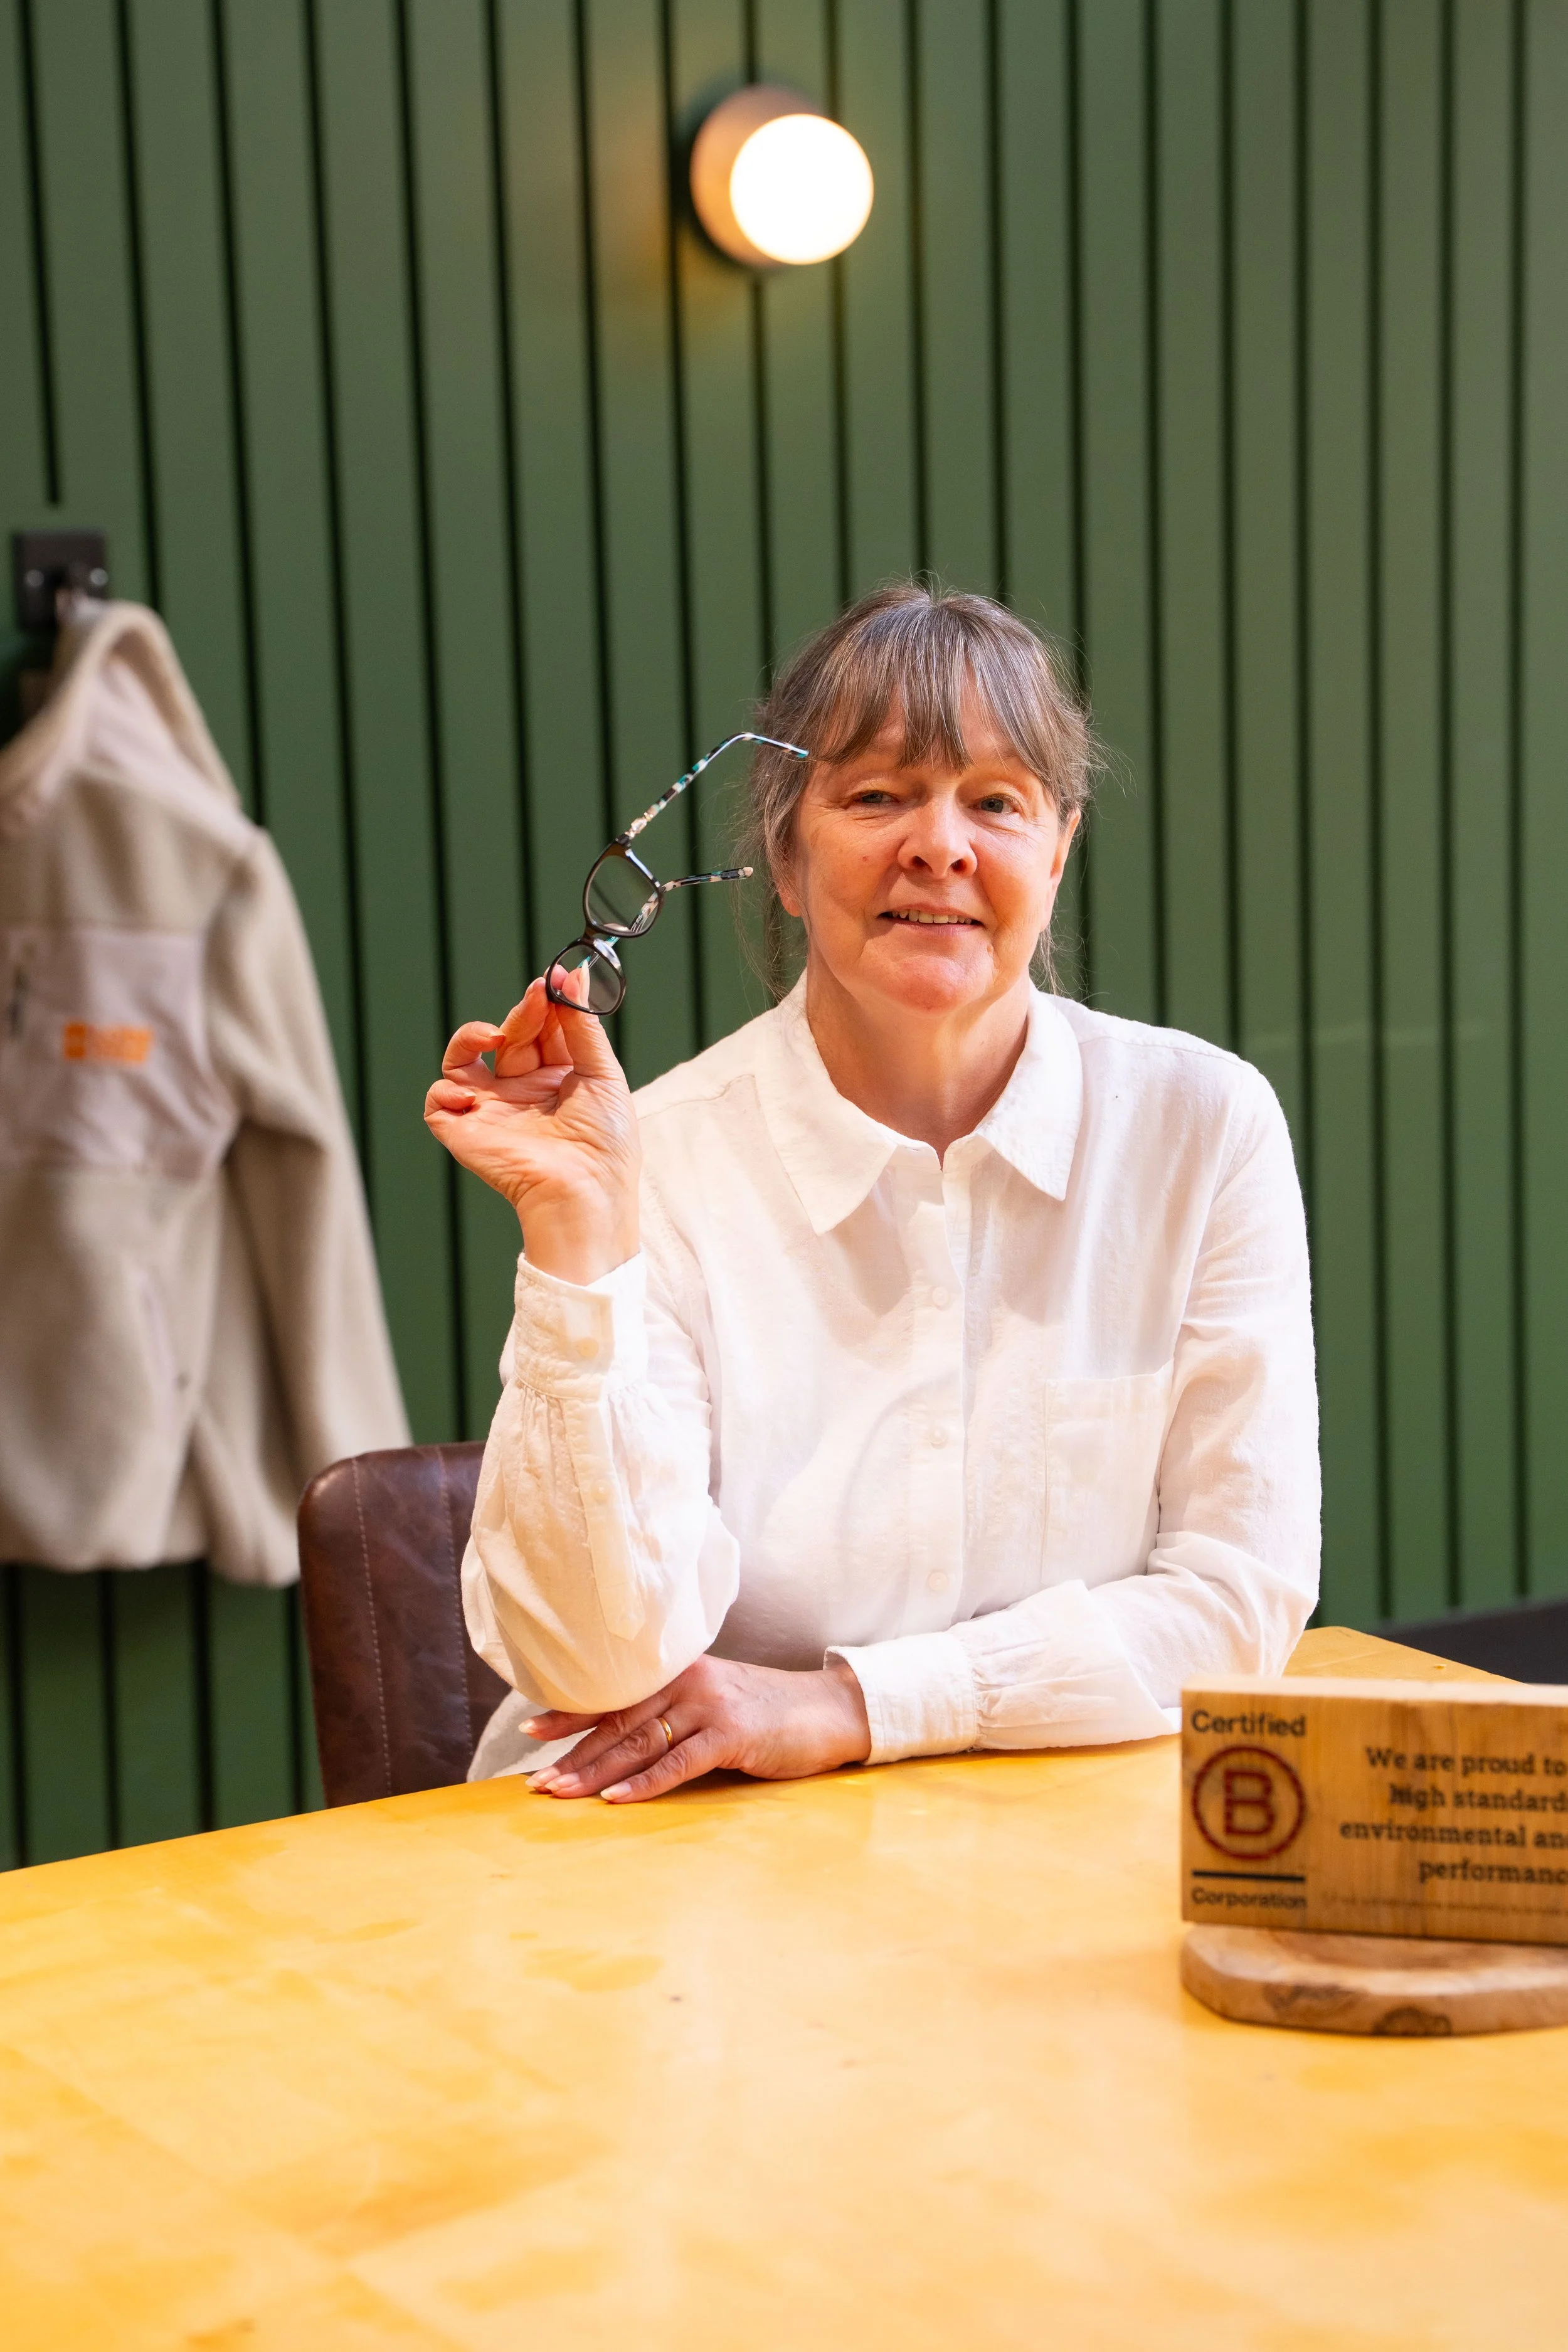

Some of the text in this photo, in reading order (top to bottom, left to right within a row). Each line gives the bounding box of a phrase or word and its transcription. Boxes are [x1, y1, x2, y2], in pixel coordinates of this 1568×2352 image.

[1192, 1708, 1306, 1737] Certified
[1365, 1745, 1567, 1777] We are proud to
[1224, 1769, 1276, 1837] B
[1339, 1818, 1568, 1849] environmental an
[1192, 1886, 1308, 1910] Corporation
